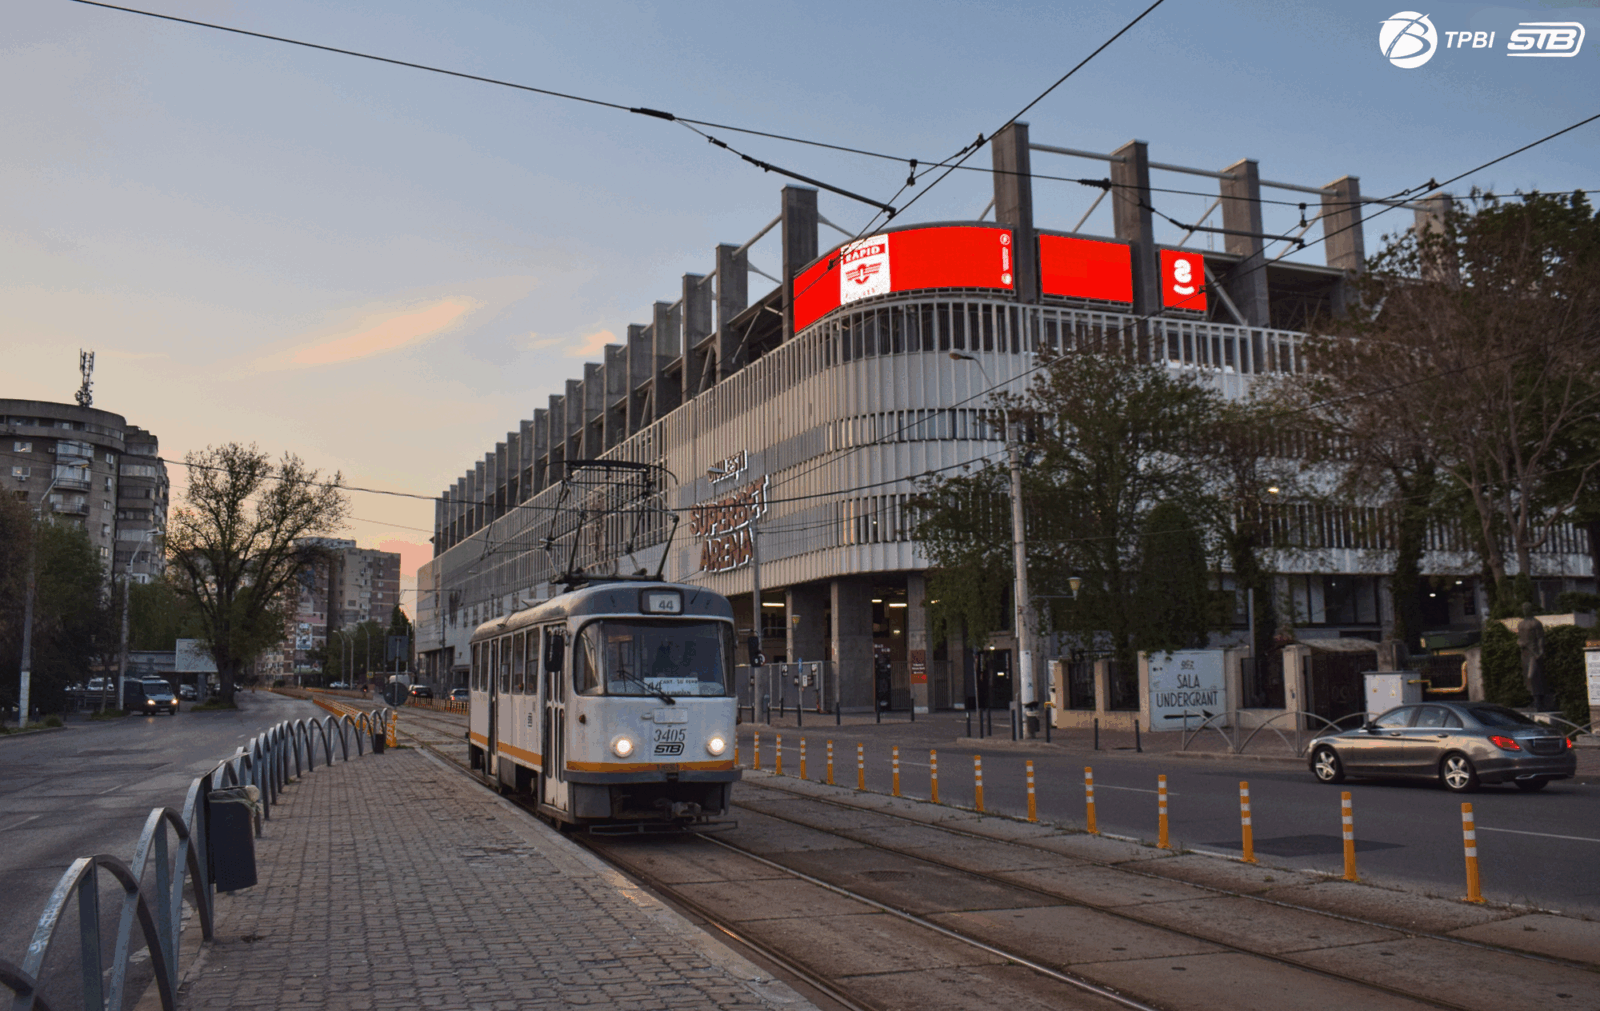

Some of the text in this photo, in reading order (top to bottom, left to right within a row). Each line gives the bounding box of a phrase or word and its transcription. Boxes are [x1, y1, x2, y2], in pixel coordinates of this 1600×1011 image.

[845, 246, 881, 263] RAPID
[700, 528, 754, 573] ARENA
[658, 599, 674, 610] 44
[1177, 674, 1201, 689] SALA
[1156, 691, 1219, 708] UNDERGRANT
[654, 728, 687, 742] 3405
[654, 743, 682, 754] STB
